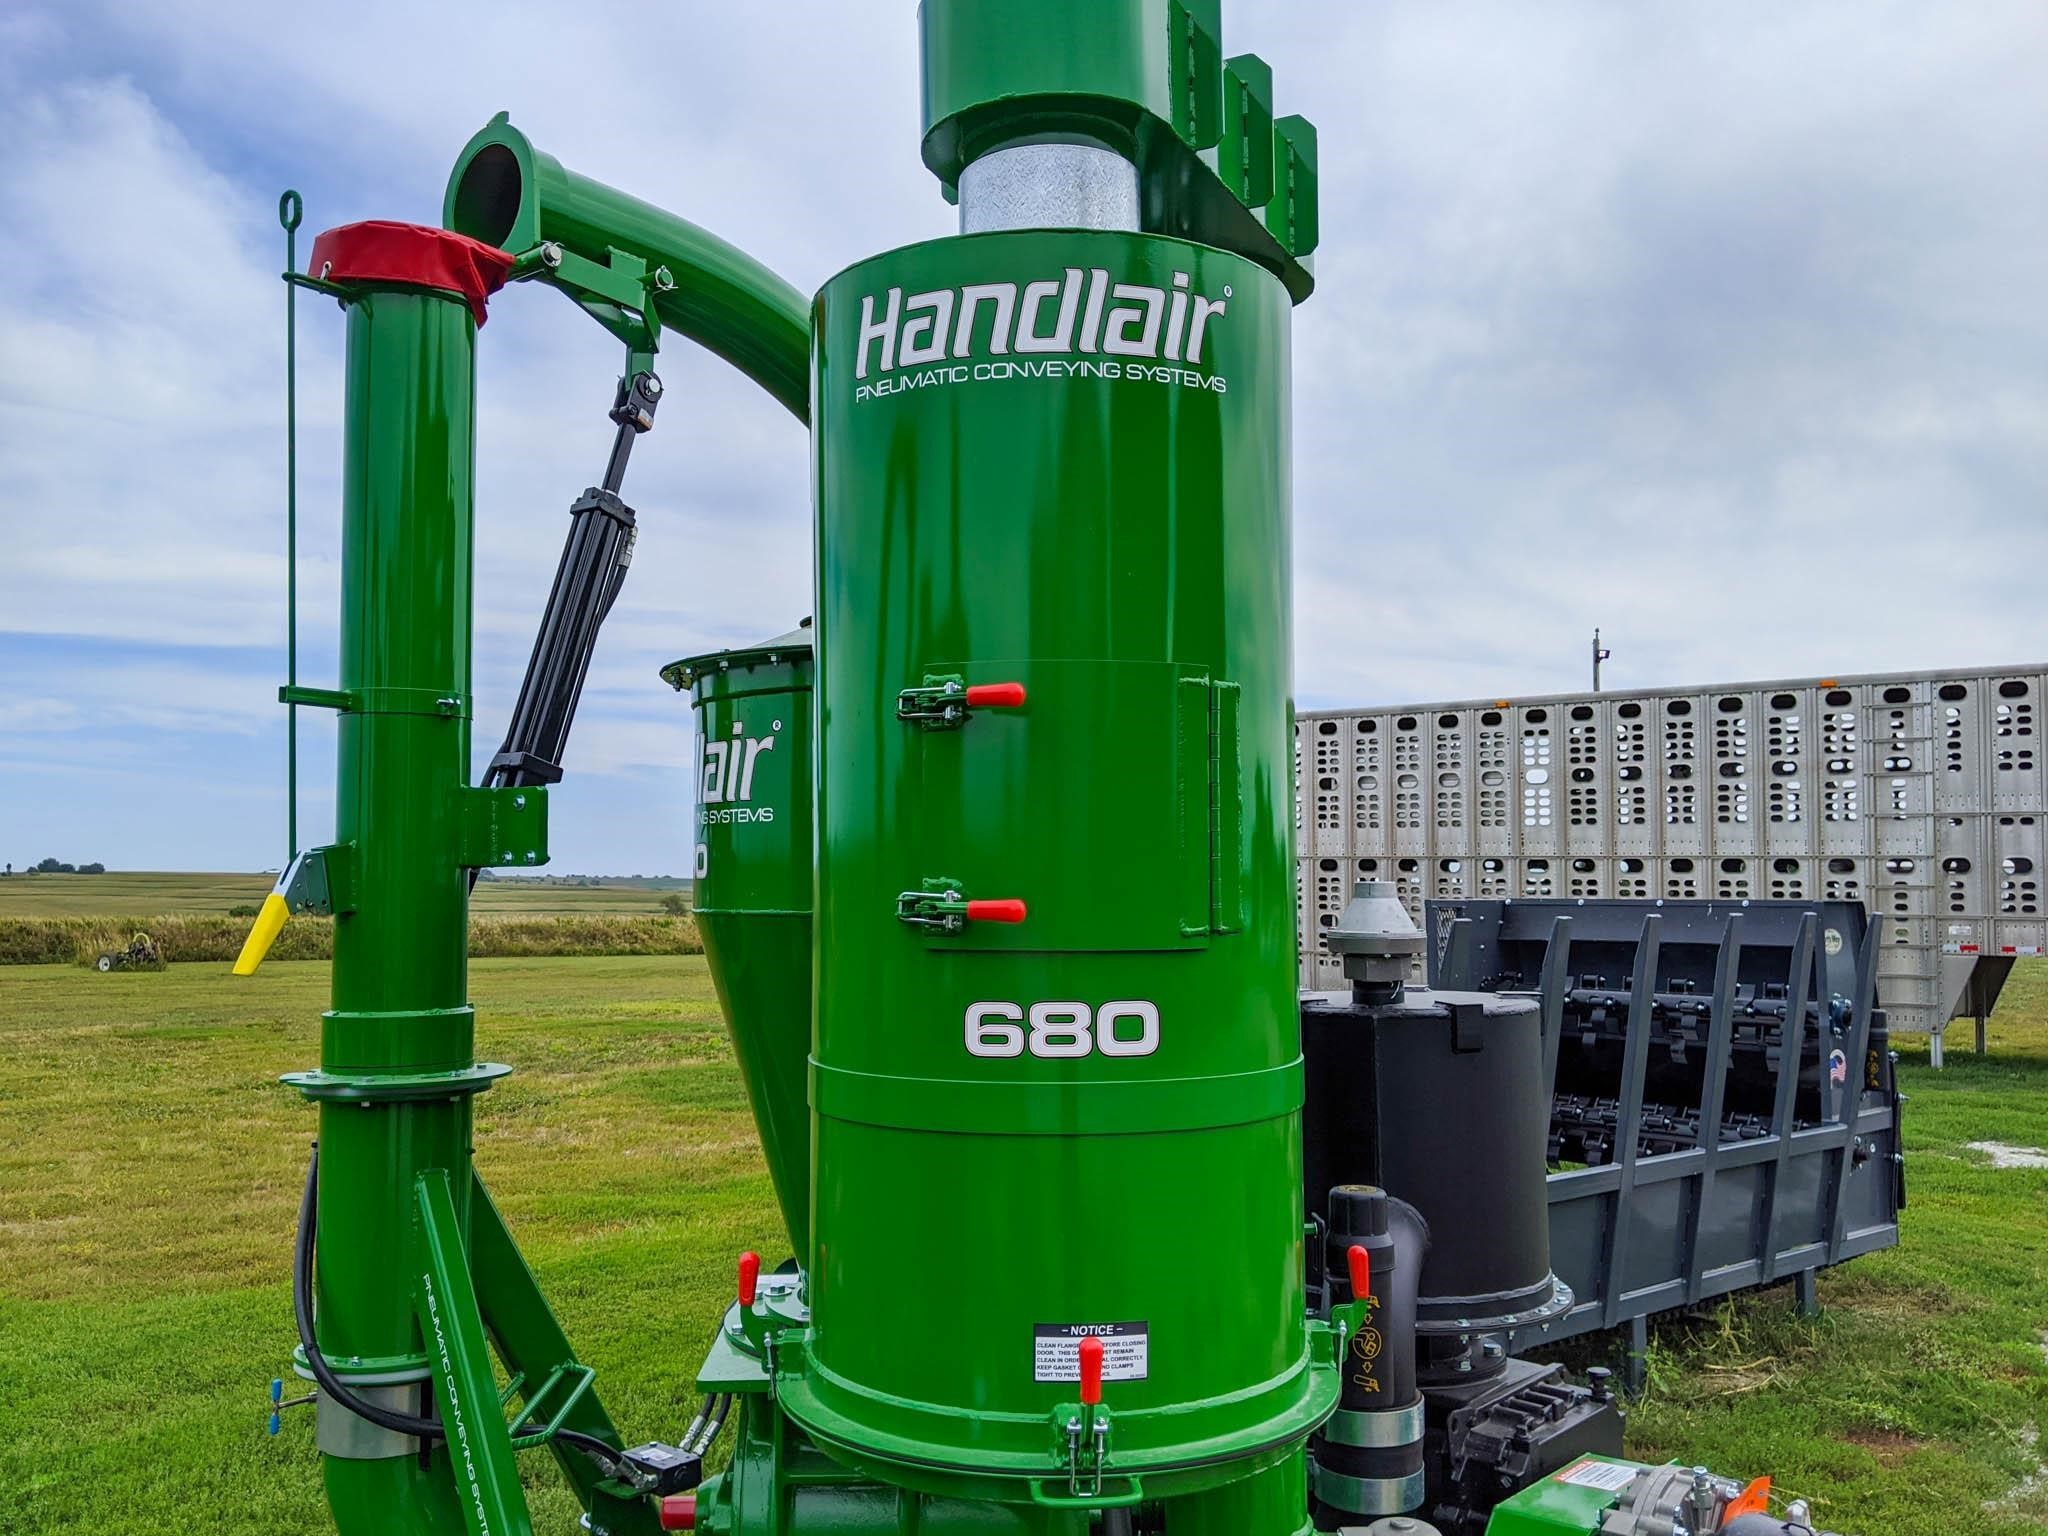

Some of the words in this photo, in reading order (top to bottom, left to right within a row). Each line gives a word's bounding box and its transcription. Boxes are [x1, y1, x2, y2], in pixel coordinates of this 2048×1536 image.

[856, 365, 968, 403] PNEUMATIC
[974, 361, 1122, 381] CONVEYING
[1126, 364, 1227, 393] SYSTEMS
[708, 807, 774, 824] SYSTEMS
[964, 1000, 1160, 1058] 680
[423, 1273, 451, 1373] PNEUMATIC
[446, 1375, 476, 1481] CONVEYING
